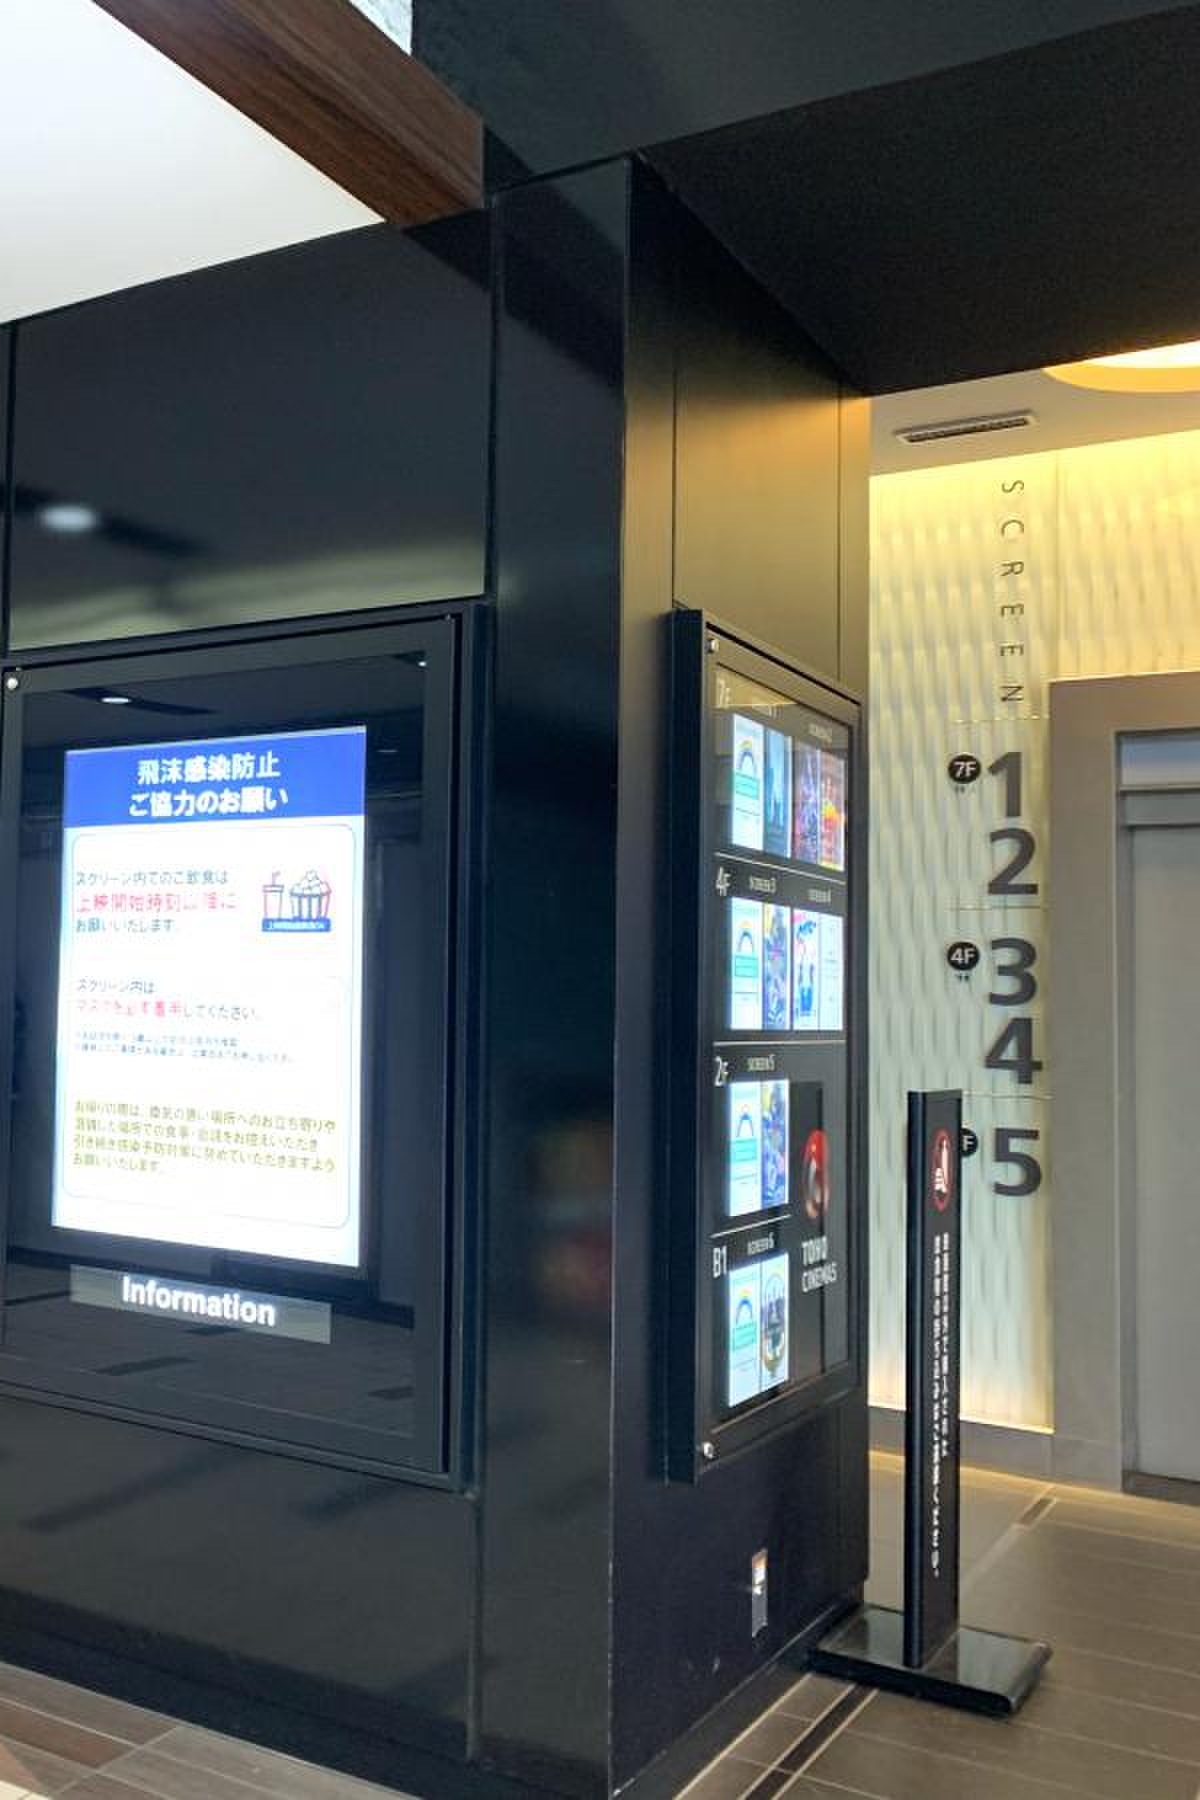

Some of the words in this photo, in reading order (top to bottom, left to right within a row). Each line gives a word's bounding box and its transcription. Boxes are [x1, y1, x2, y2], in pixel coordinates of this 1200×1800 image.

[1000, 479, 1025, 703] SCREEN
[137, 751, 282, 785] 飛沫感染防止
[953, 761, 977, 779] 7F
[987, 751, 1022, 817] 1
[129, 786, 289, 818] ご協力のお願い
[987, 828, 1038, 895] 2
[951, 947, 976, 964] 4F
[988, 938, 1037, 1006] 3
[984, 1017, 1043, 1084] 4
[993, 1128, 1042, 1197] 5
[121, 1275, 276, 1327] Information
